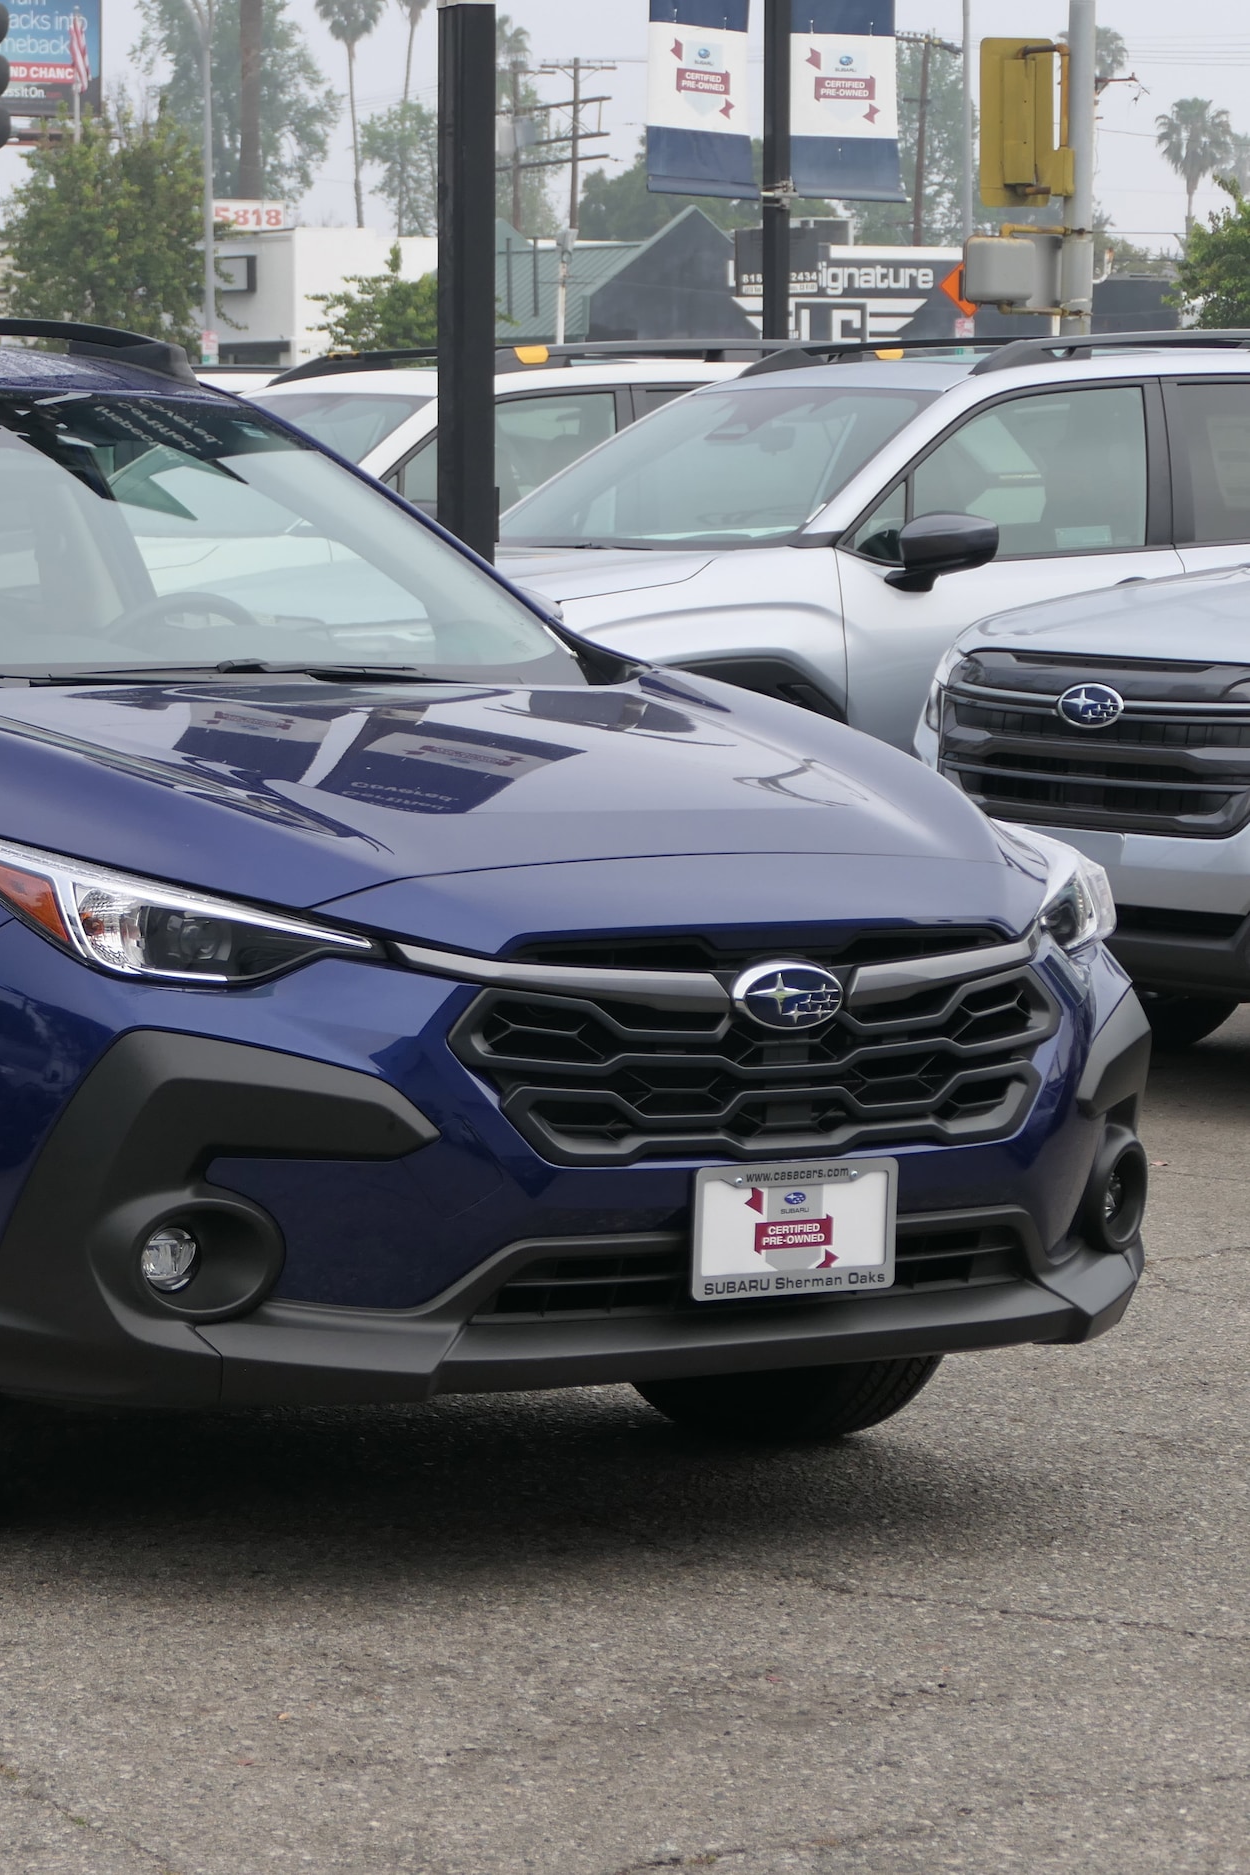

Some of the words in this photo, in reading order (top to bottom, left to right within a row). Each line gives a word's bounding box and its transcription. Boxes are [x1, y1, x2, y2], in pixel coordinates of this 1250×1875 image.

[8, 10, 51, 31] acks
[9, 66, 28, 78] ND
[29, 66, 75, 80] CHANC
[685, 72, 722, 83] CERTIFIED
[681, 80, 725, 92] PRE-OWNED
[825, 80, 865, 89] CERTIFIED
[820, 88, 869, 97] PRE-OWNED
[214, 206, 282, 226] 5818
[746, 1167, 850, 1183] www.casacars.com
[780, 1207, 810, 1215] SUBARU
[768, 1222, 821, 1236] CERTIFIED
[762, 1233, 825, 1246] PRE-OWNED
[704, 1278, 770, 1296] SUBARU
[775, 1274, 842, 1290] Sherman
[848, 1271, 886, 1285] Oaks
